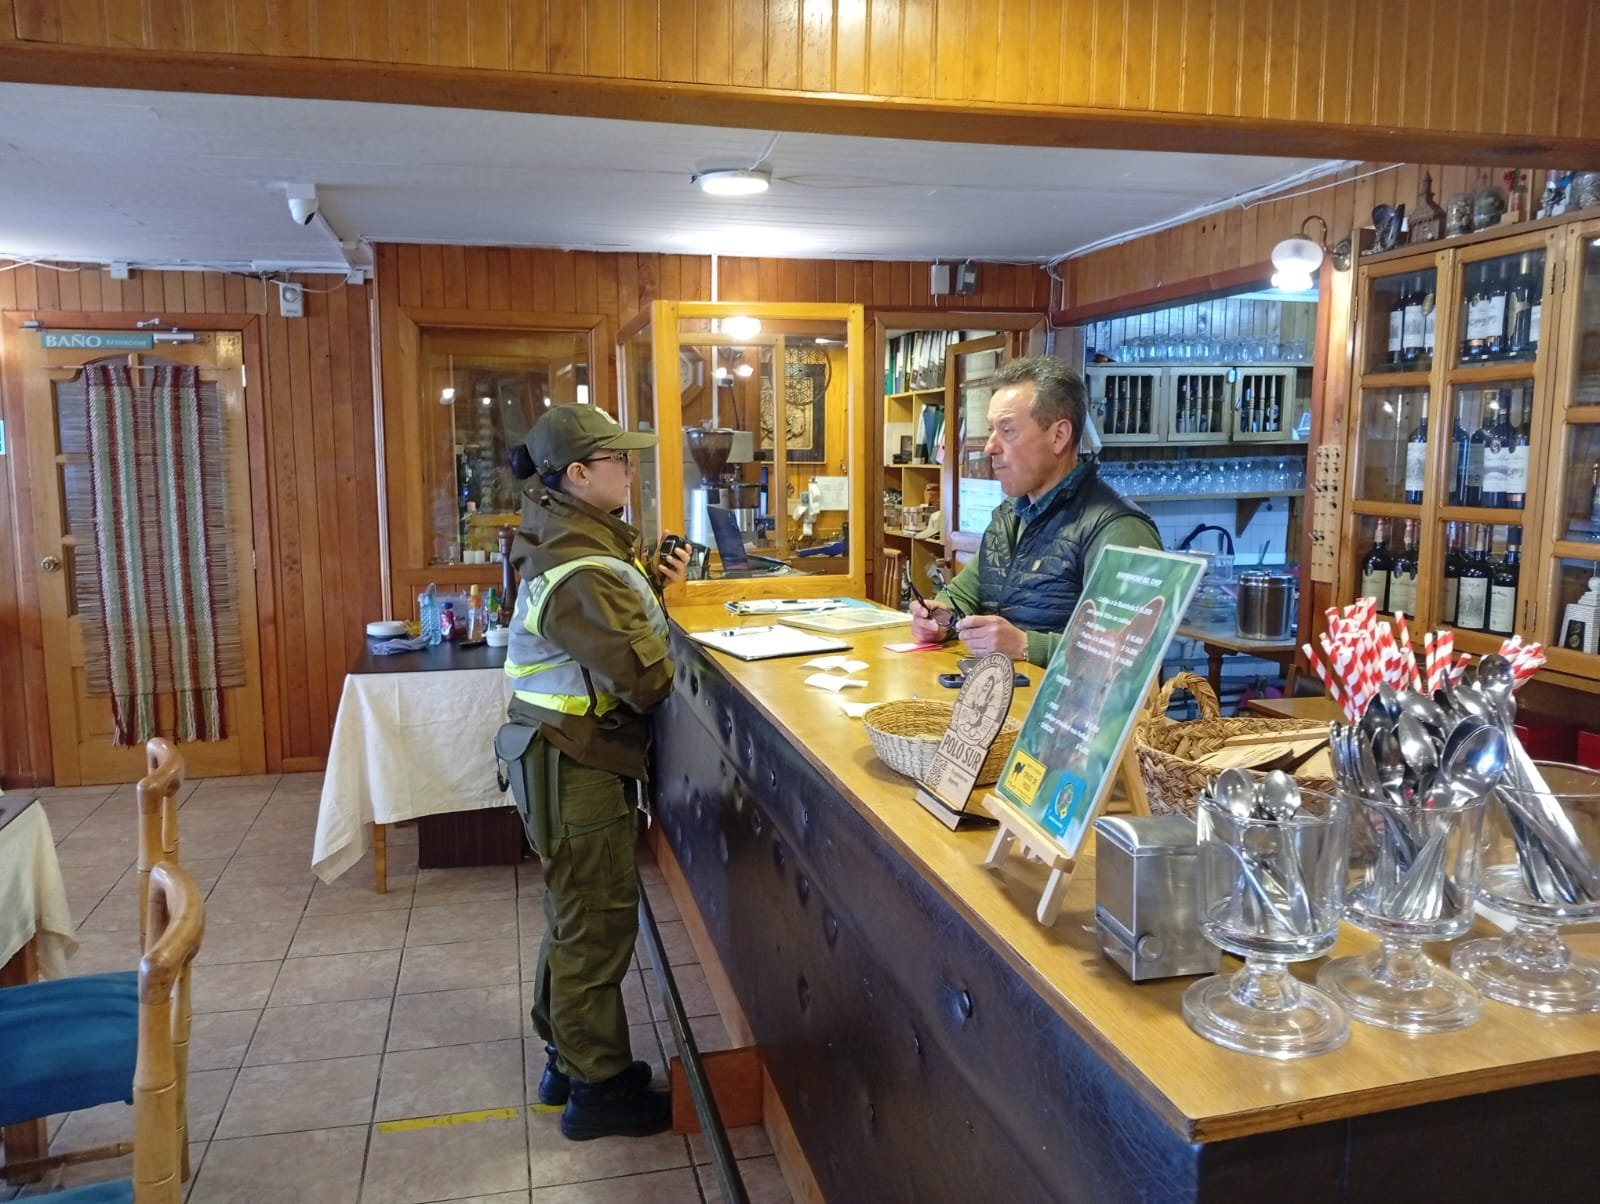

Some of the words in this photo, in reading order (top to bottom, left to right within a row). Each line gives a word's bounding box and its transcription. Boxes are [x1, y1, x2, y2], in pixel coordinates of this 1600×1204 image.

[46, 333, 101, 348] BAÑO
[941, 733, 964, 761] POLO
[964, 744, 983, 771] SUR
